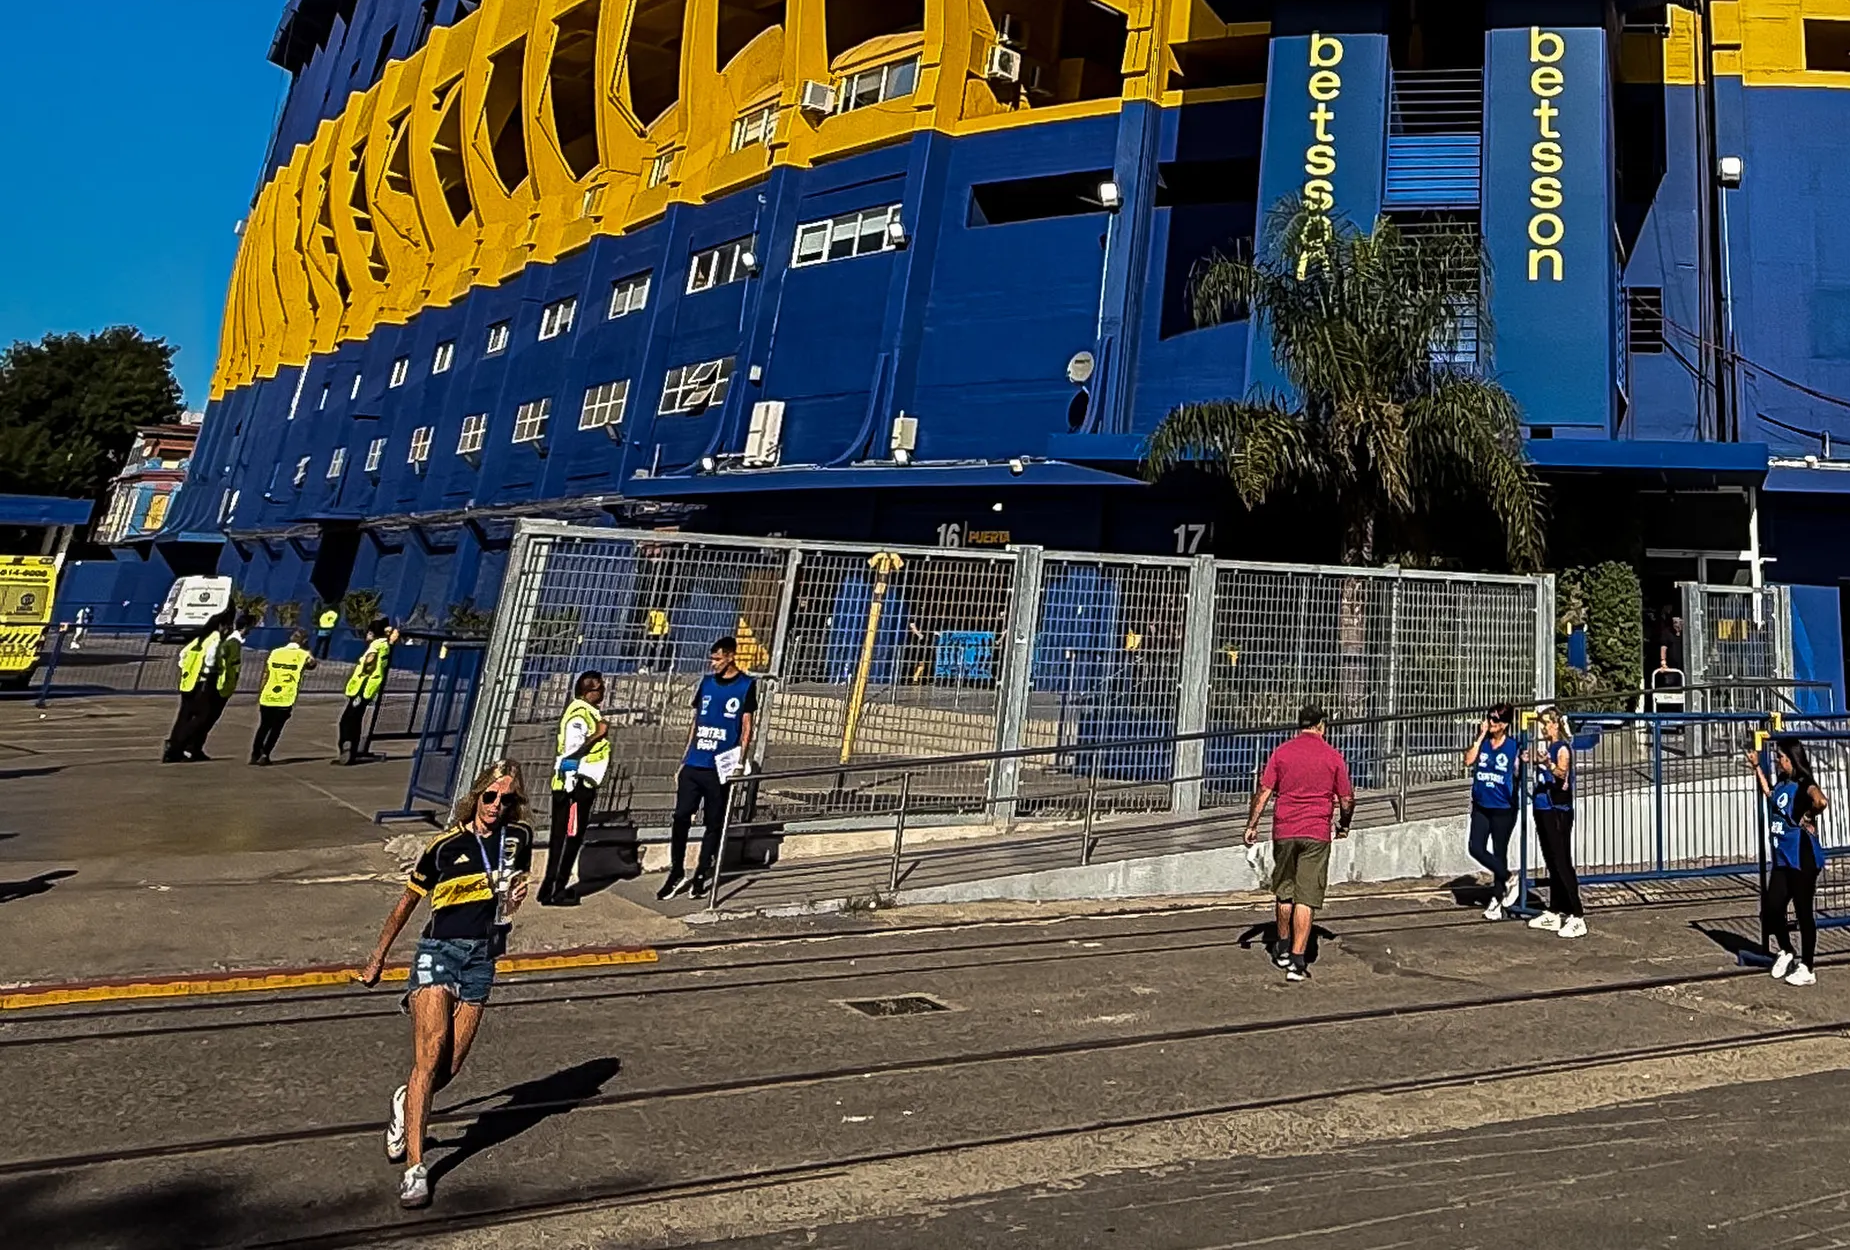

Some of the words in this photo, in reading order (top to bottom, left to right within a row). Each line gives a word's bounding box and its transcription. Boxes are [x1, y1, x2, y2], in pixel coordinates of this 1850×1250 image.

[1527, 25, 1566, 282] betsson
[936, 523, 961, 548] 16
[968, 530, 1010, 544] PUERTA
[1173, 524, 1206, 554] 17
